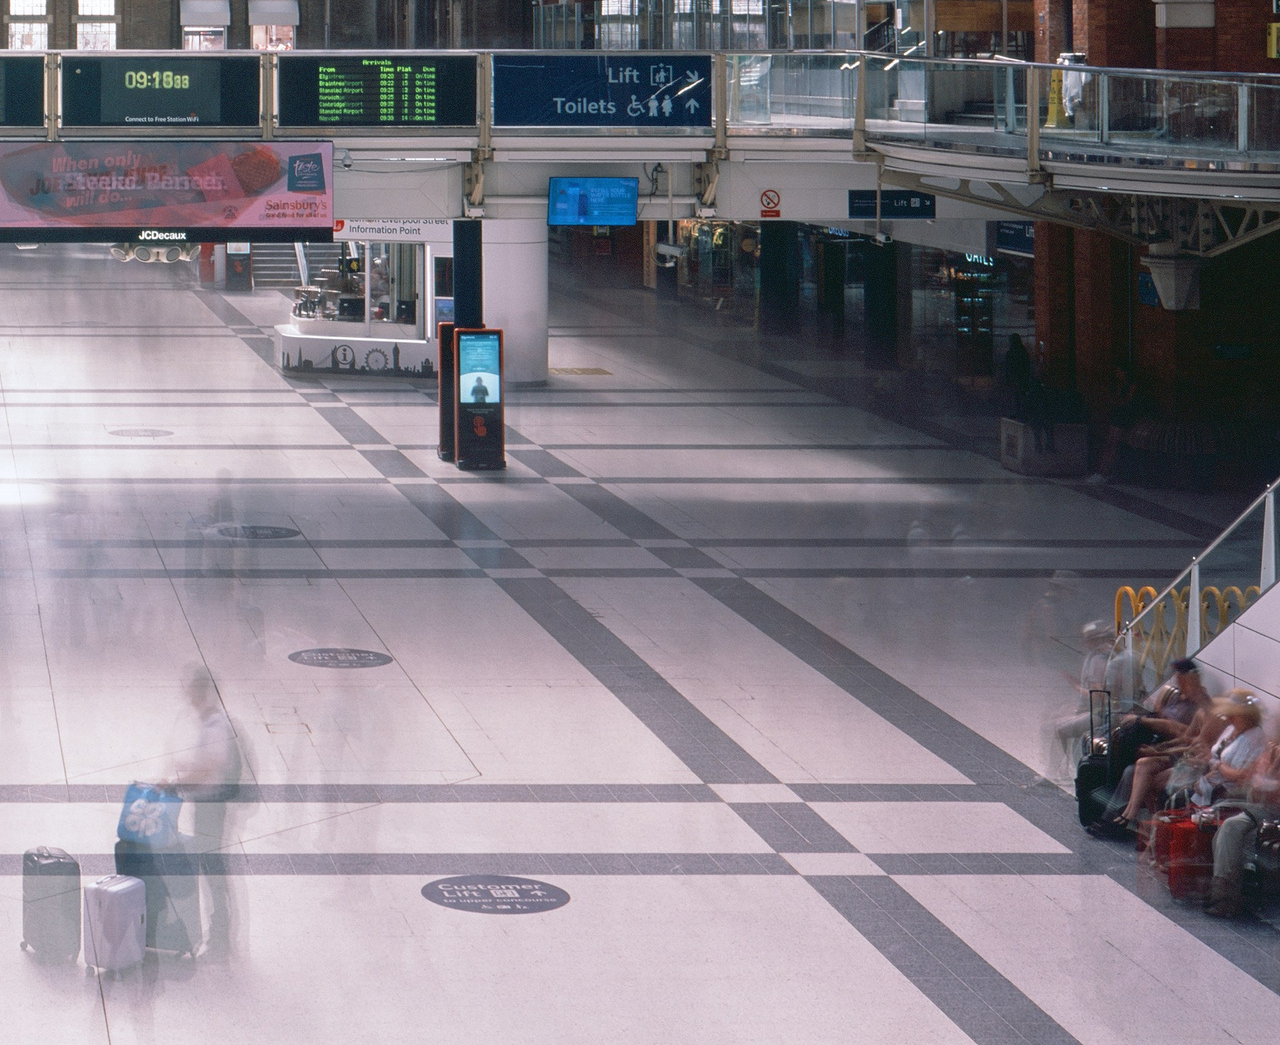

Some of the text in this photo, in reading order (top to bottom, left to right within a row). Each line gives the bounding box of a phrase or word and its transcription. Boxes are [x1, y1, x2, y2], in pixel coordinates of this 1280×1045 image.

[608, 68, 640, 83] Lift
[553, 97, 616, 114] Toilets
[52, 150, 142, 173] When only
[65, 190, 94, 208] will
[894, 199, 907, 207] Lift
[266, 200, 327, 212] Sainsbury's
[139, 231, 186, 240] JCDecaux
[349, 226, 421, 235] Information Point
